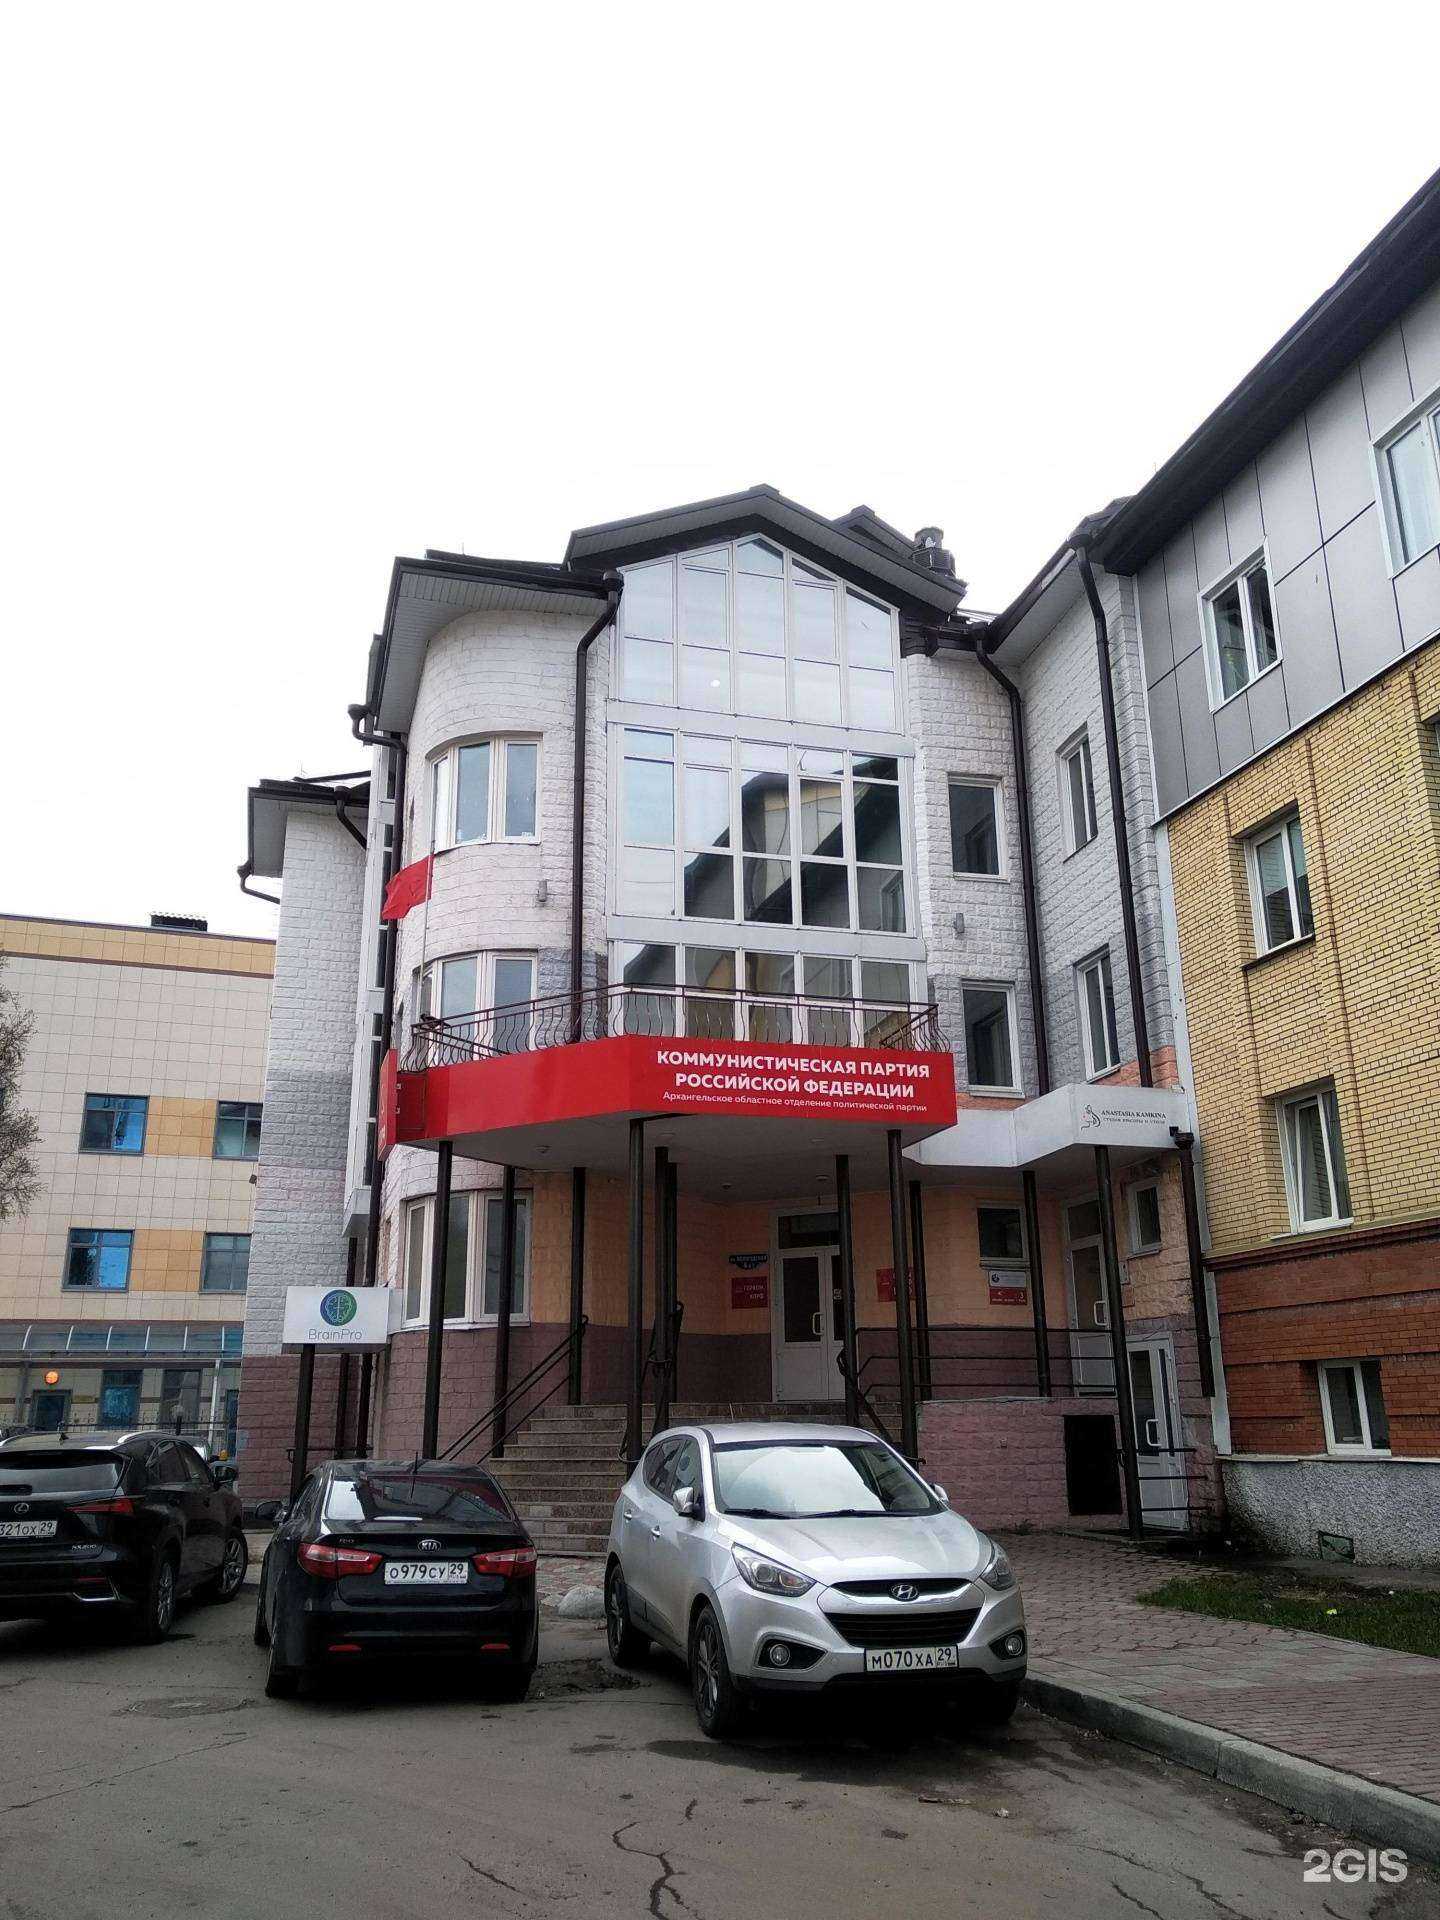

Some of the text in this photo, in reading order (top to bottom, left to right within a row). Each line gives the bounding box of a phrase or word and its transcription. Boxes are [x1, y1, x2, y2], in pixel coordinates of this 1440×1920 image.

[656, 1050, 930, 1078] КОММУНИСТИЧЕСКАЯ ПАРТИЯ
[675, 1073, 914, 1099] РОССИЙСКОЙ ФЕДЕРАЦИИ
[662, 1091, 733, 1103] Архангельское
[735, 1096, 783, 1105] областное
[784, 1099, 832, 1107] отделение
[833, 1101, 895, 1110] политической
[1136, 1111, 1167, 1119] KAMKINA
[307, 1328, 363, 1340] BrainPro
[40, 1522, 53, 1533] 29
[449, 1563, 465, 1575] 29
[937, 1648, 952, 1661] 29
